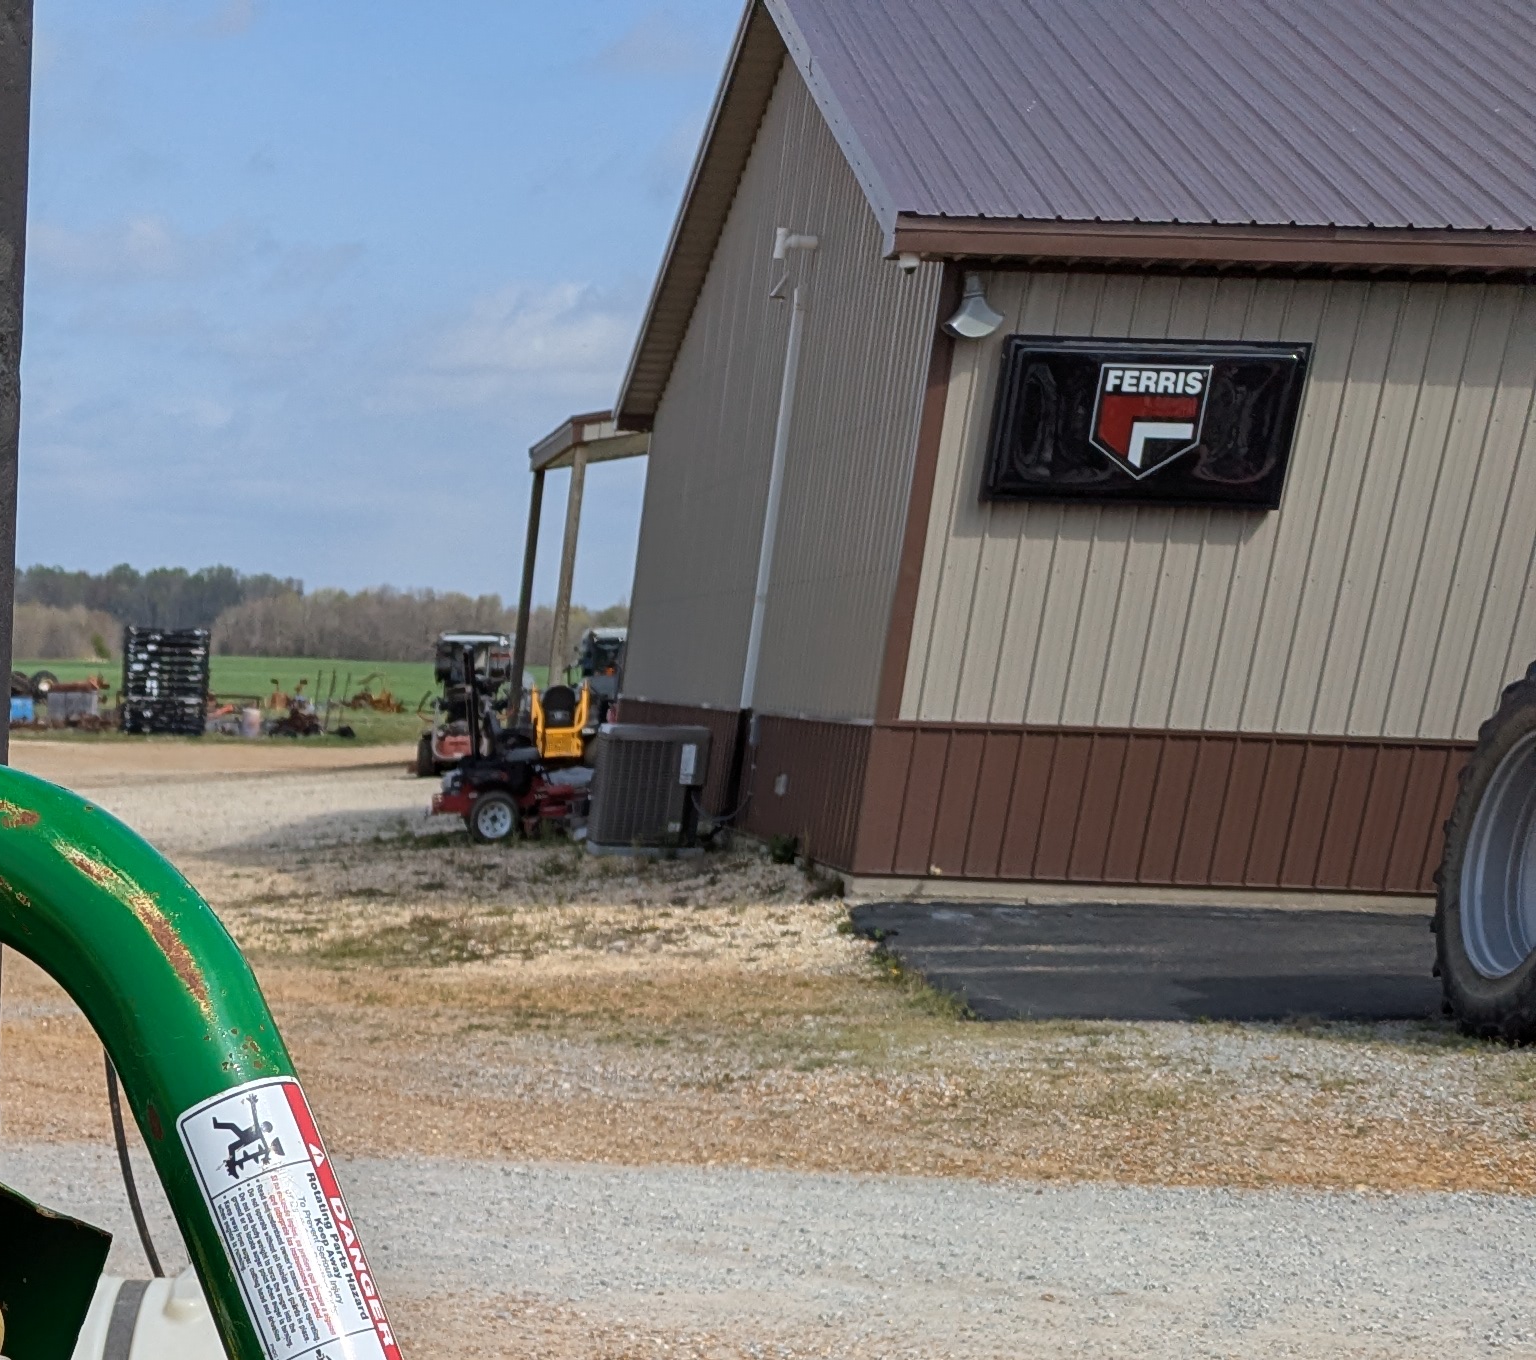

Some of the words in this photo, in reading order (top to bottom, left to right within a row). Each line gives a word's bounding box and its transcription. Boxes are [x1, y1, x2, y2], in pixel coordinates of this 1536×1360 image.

[1105, 369, 1203, 395] FERRIS
[297, 1196, 308, 1208] To
[301, 1208, 321, 1244] Prevent
[304, 1171, 334, 1230] Rotating
[329, 1232, 350, 1270] Parts
[344, 1271, 369, 1321] Hazard
[312, 1216, 331, 1247] Keep
[324, 1247, 343, 1280] Away
[315, 1244, 334, 1279] Serious
[328, 1194, 396, 1348] DANGER
[328, 1278, 345, 1306] Injury
